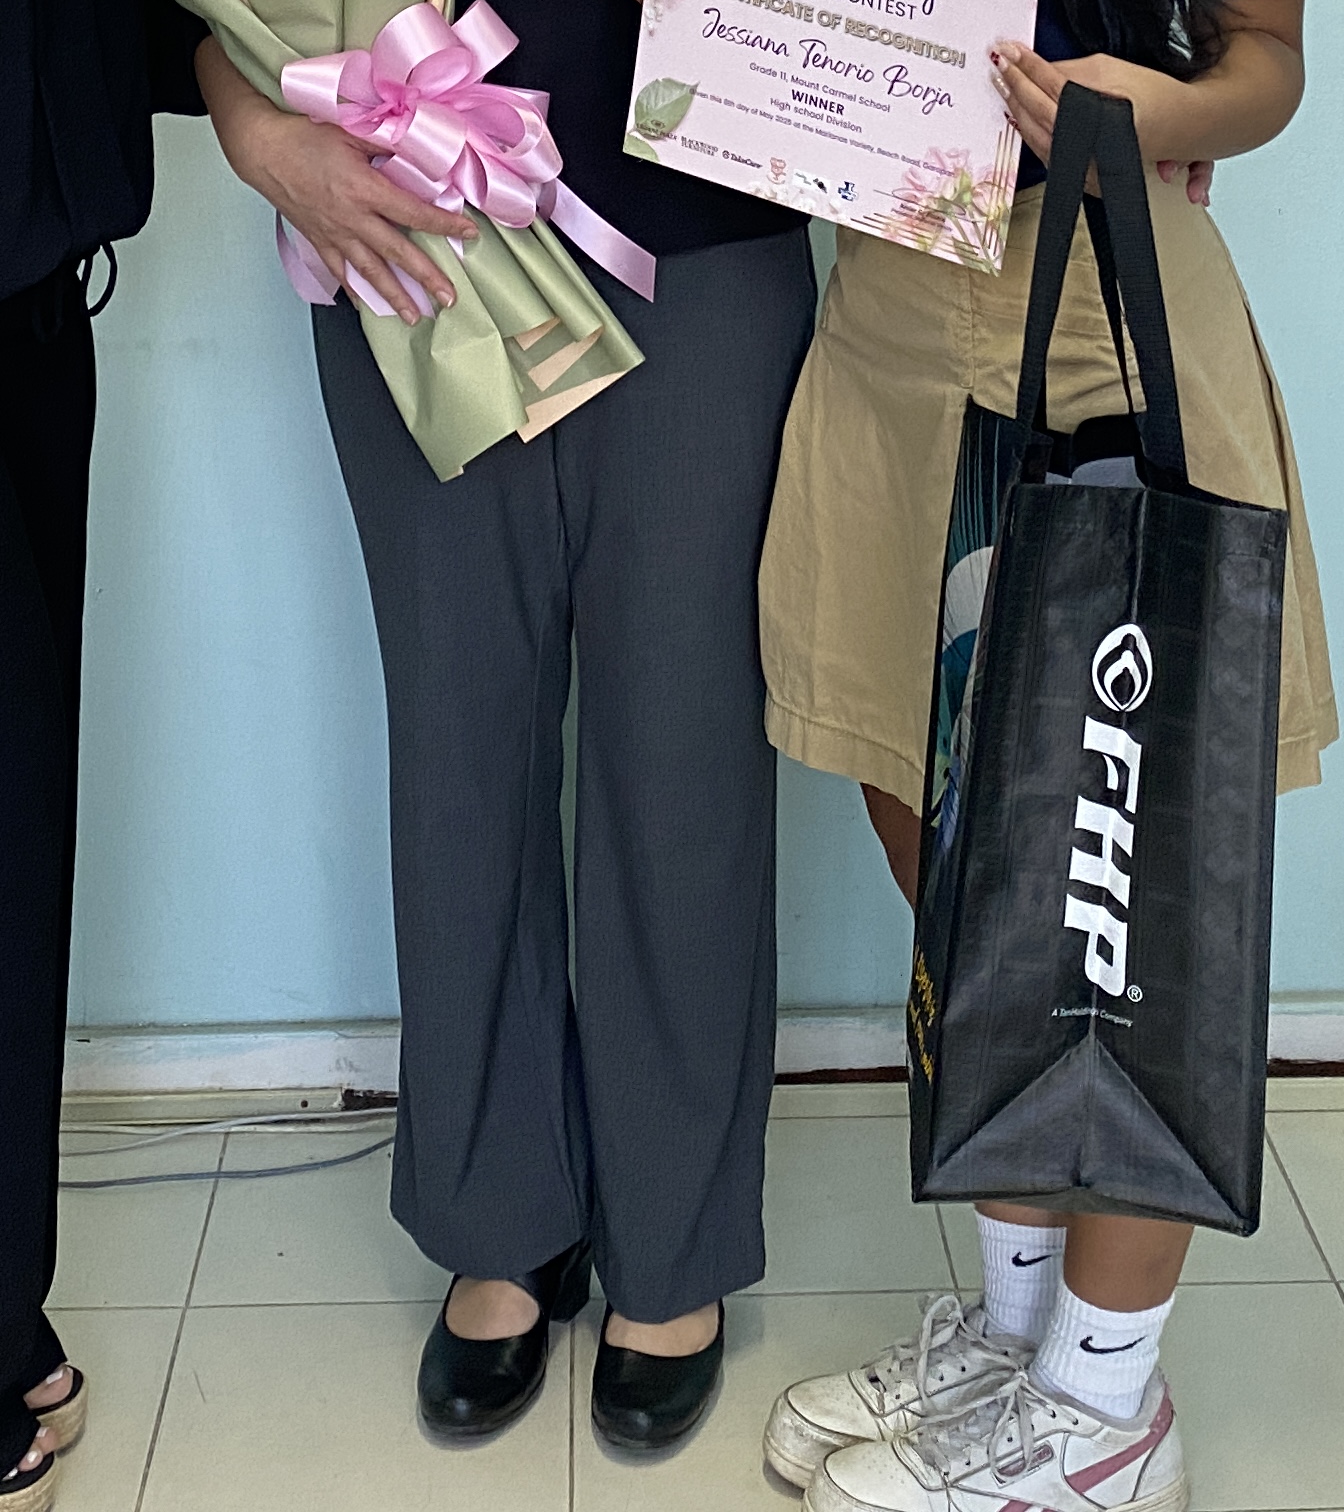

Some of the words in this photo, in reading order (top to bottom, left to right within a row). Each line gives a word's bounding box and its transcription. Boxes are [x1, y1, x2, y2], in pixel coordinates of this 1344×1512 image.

[702, 7, 789, 58] Jessiana
[798, 38, 875, 84] Tenorio
[882, 64, 955, 115] Borja
[817, 9, 843, 31] OF
[844, 16, 967, 69] RECOGNITION
[735, 103, 750, 114] day
[759, 110, 774, 121] May
[749, 62, 777, 78] Grade
[790, 74, 820, 91] Mount
[821, 85, 857, 103] Carmel
[858, 96, 891, 113] School
[791, 89, 845, 116] WINNER
[769, 97, 791, 113] High
[793, 105, 824, 122] school
[825, 115, 862, 134] Division
[1064, 715, 1142, 997] FHP
